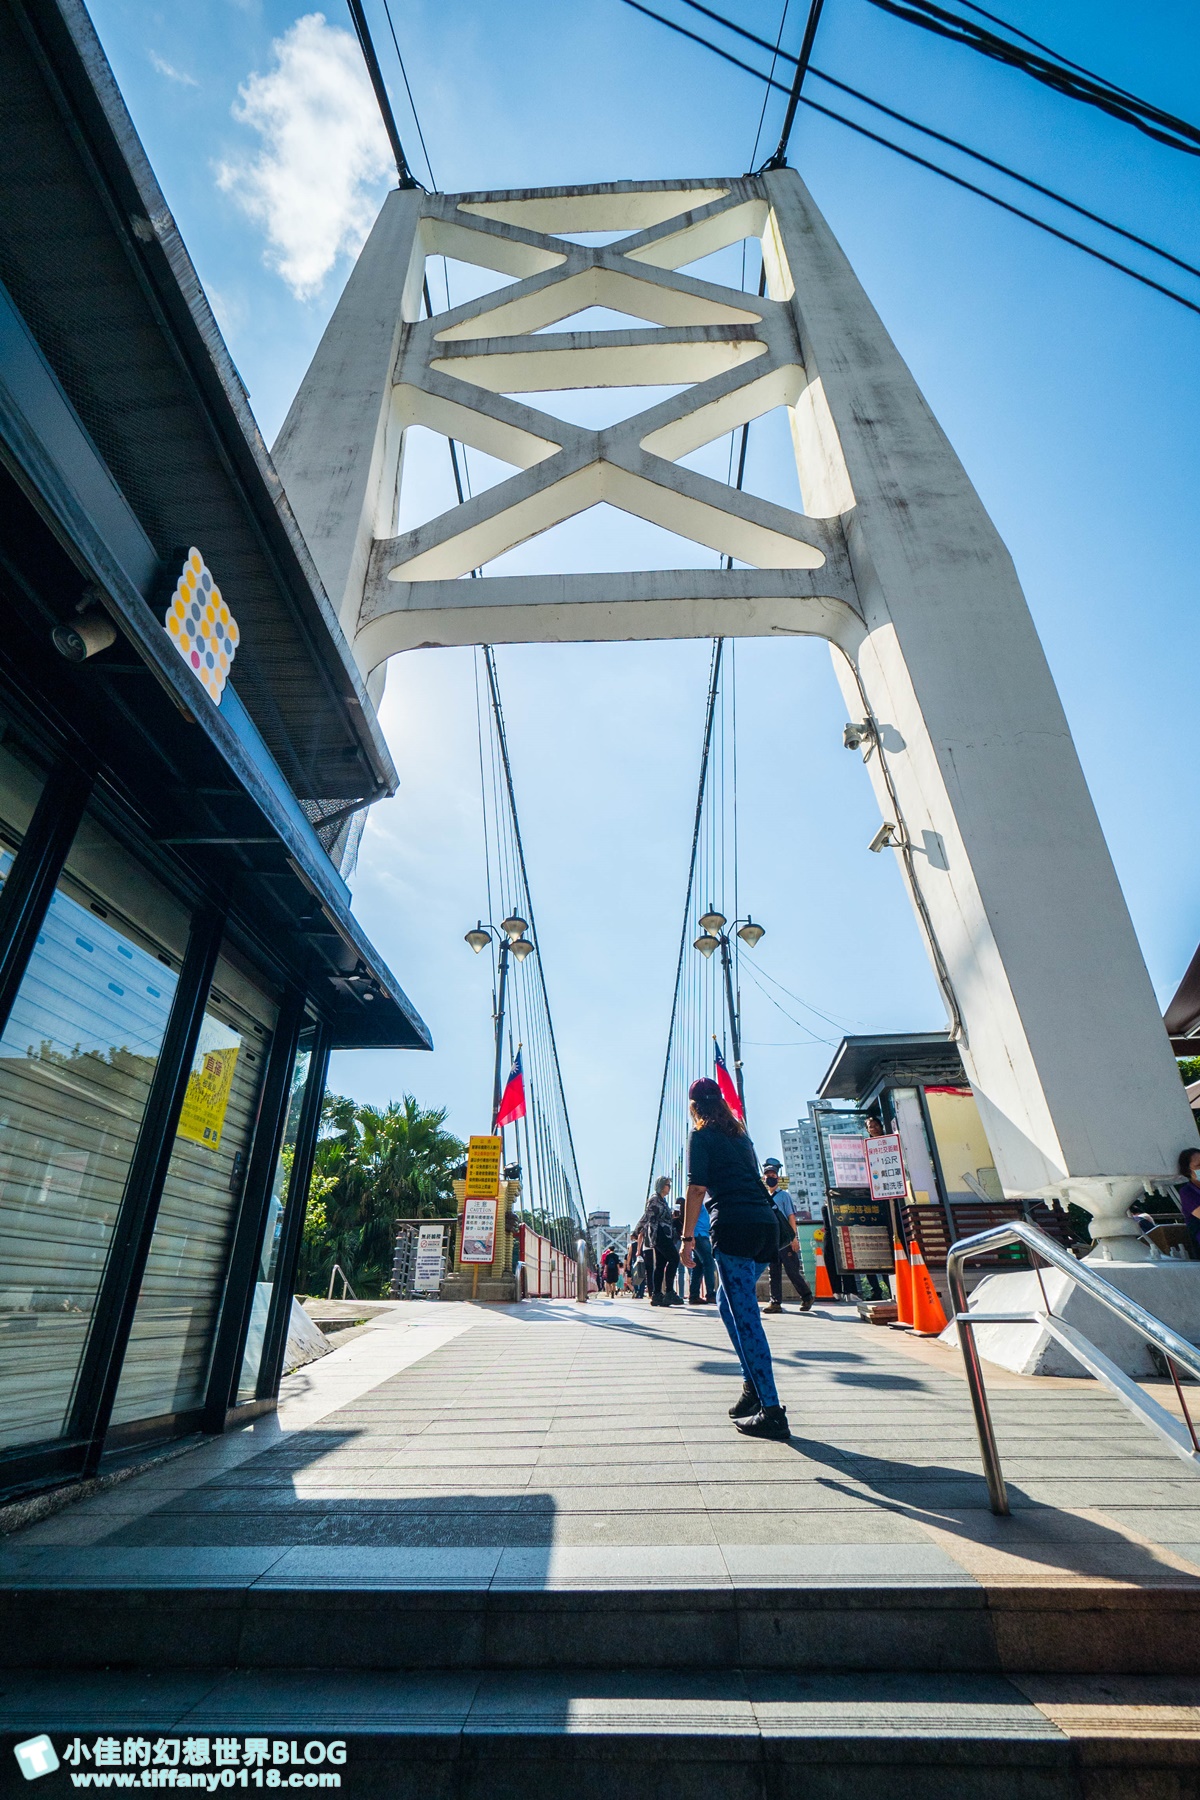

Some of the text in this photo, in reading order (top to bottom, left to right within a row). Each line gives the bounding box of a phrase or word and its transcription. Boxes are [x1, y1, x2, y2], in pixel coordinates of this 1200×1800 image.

[868, 1144, 899, 1156] 保持社交距離
[881, 1155, 898, 1165] 1公尺
[881, 1168, 901, 1178] 戴口罩
[882, 1181, 903, 1191] 勤洗手
